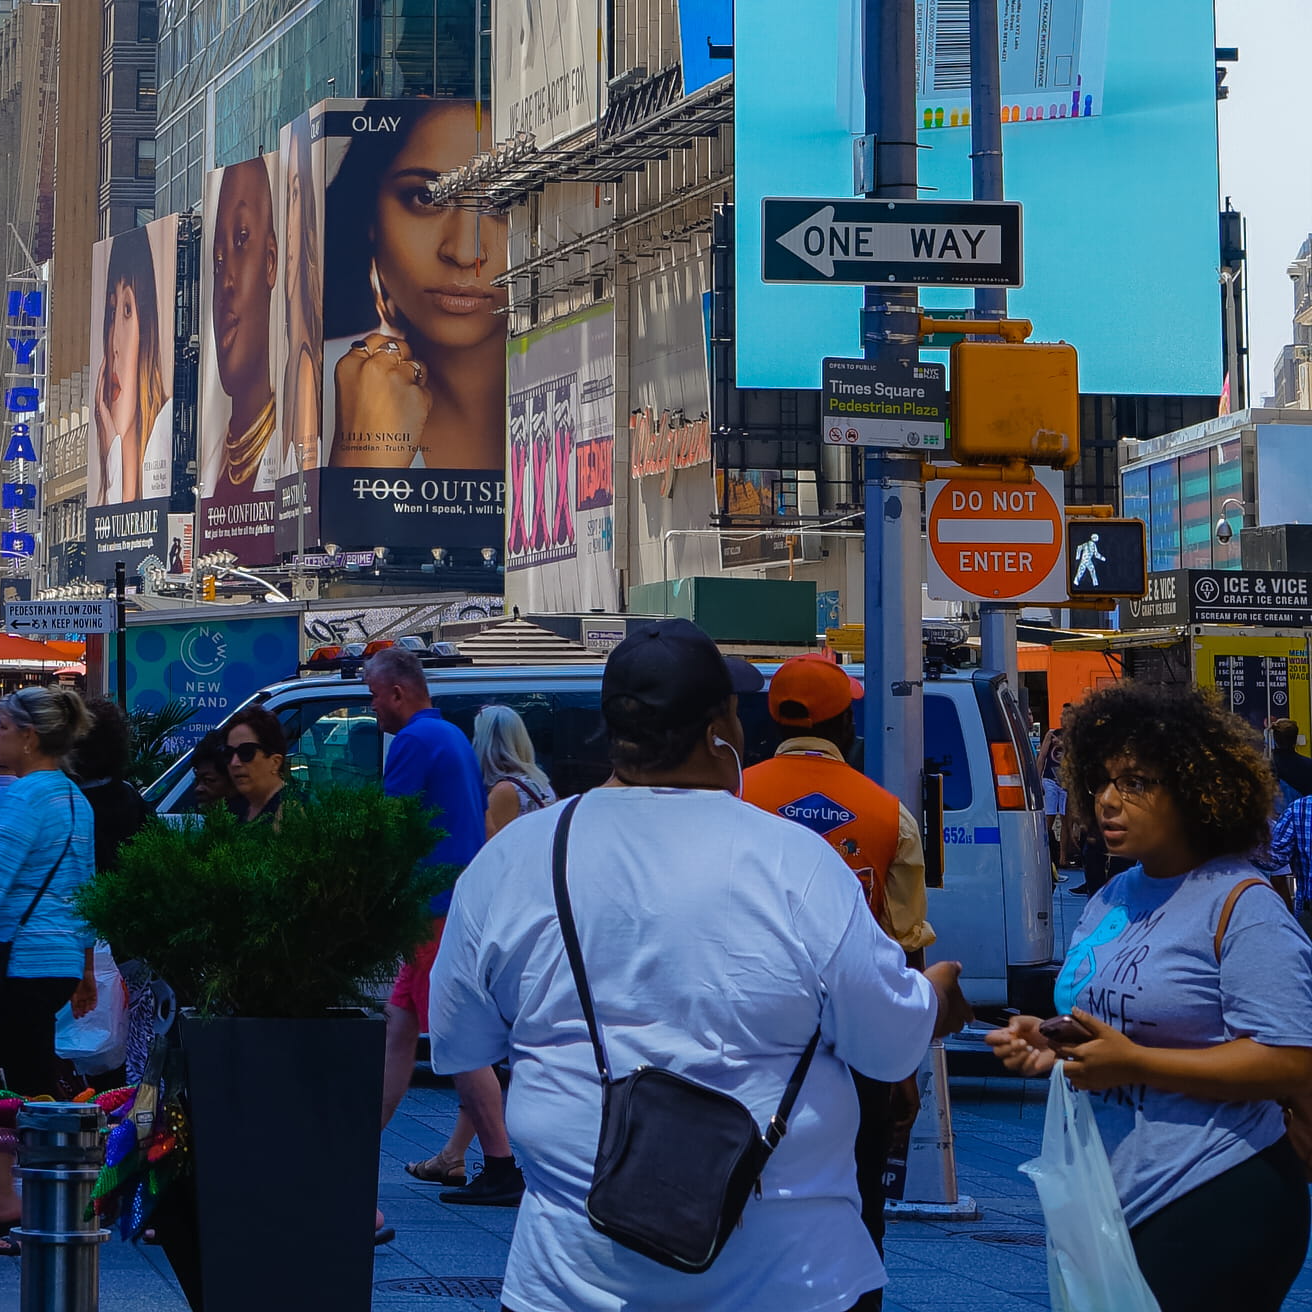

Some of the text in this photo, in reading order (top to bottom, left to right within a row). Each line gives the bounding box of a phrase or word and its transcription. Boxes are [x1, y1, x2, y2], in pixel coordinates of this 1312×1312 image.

[546, 72, 570, 121] ARCTIC
[571, 63, 585, 108] FOX
[352, 116, 401, 132] OLAY
[802, 225, 986, 260] ONE WAY
[855, 364, 877, 372] PUBLIC
[829, 379, 925, 399] Times Square
[829, 398, 938, 417] Pedestrian Plaza
[375, 432, 410, 442] SINGH
[384, 444, 405, 452] Truth
[353, 479, 414, 500] TOO
[393, 503, 423, 513] When
[431, 504, 466, 515] speak,
[475, 504, 494, 514] will
[952, 490, 1037, 513] DO NOT
[227, 501, 276, 524] CONFIDENT
[111, 509, 159, 538] VULNERABLE
[958, 549, 1034, 573] ENTER
[1159, 576, 1176, 600] VICE
[1223, 577, 1307, 594] ICE & VICE
[1223, 595, 1308, 605] CRAFT ICE CREAM
[9, 604, 103, 616] PEDESTRIAN FLOW ZONE
[1200, 612, 1231, 620] SCREAM
[1249, 613, 1263, 621] ICE
[1264, 613, 1294, 621] CREAM!
[51, 618, 103, 628] KEEP MOVING
[185, 681, 221, 693] NEW
[178, 696, 228, 708] STAND
